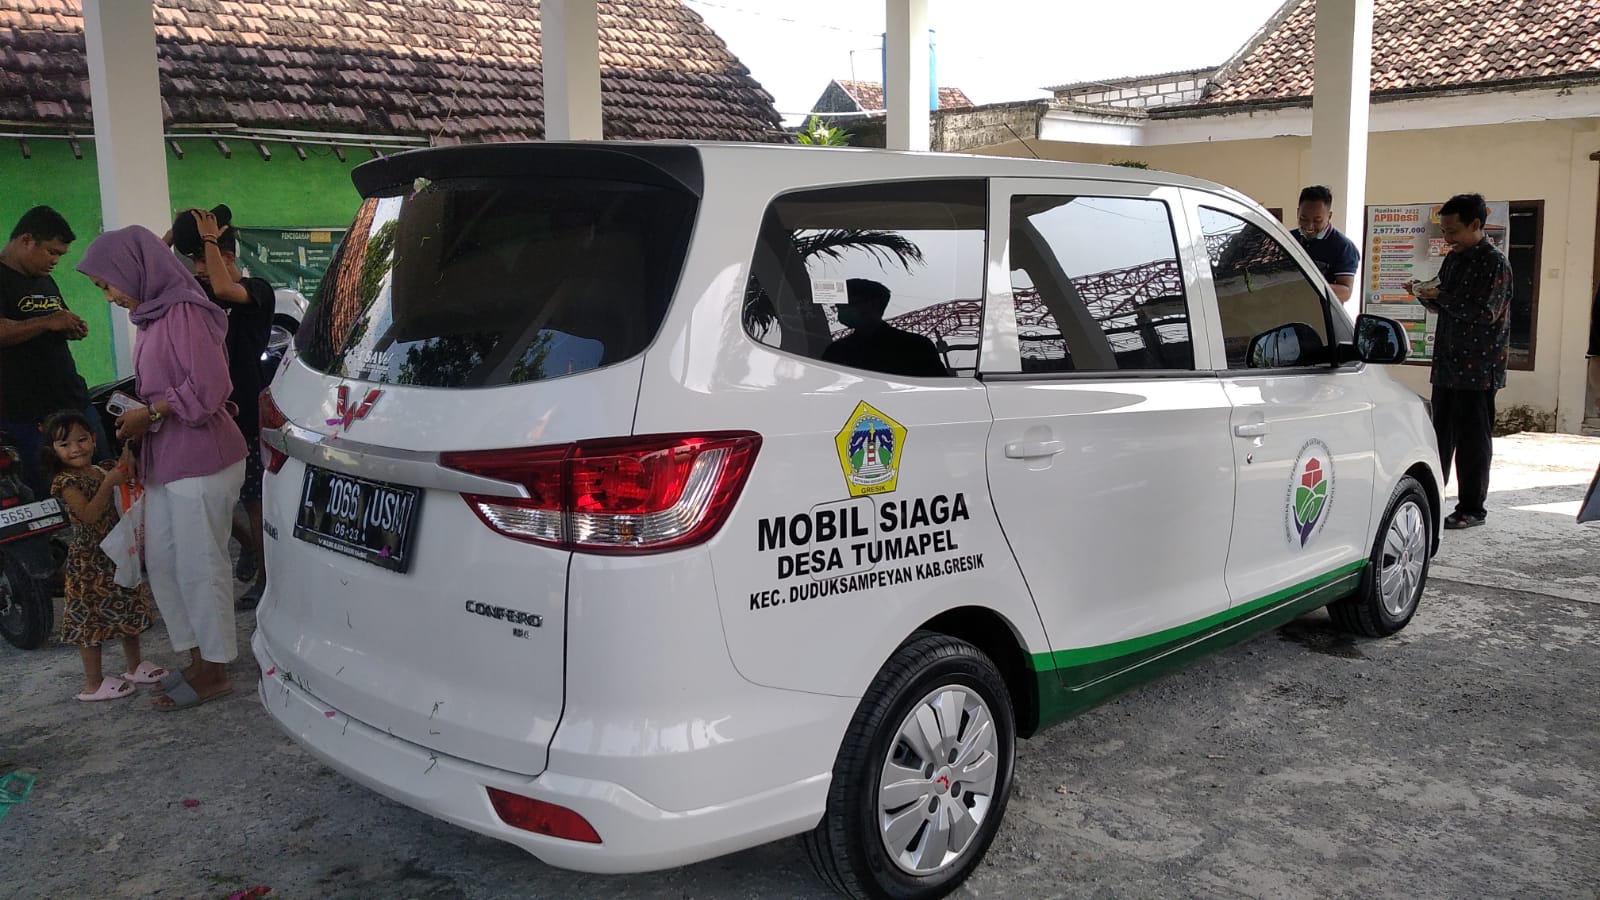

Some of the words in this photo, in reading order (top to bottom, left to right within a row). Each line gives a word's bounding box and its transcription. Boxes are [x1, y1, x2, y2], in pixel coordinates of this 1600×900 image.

[1374, 214, 1419, 222] APBDesa
[304, 471, 314, 507] L
[370, 489, 408, 534] USM
[861, 486, 886, 494] GRESIK
[0, 507, 33, 524] 5655
[758, 506, 869, 552] MOBIL
[879, 493, 970, 533] SIAGA
[777, 548, 844, 580] DESA
[851, 529, 958, 567] TUMAPEL
[750, 589, 786, 611] KEC.
[789, 566, 913, 604] DUDUKSAMPEYAN
[916, 553, 985, 580] KAB.GRESIK
[465, 600, 543, 628] CONFERO
